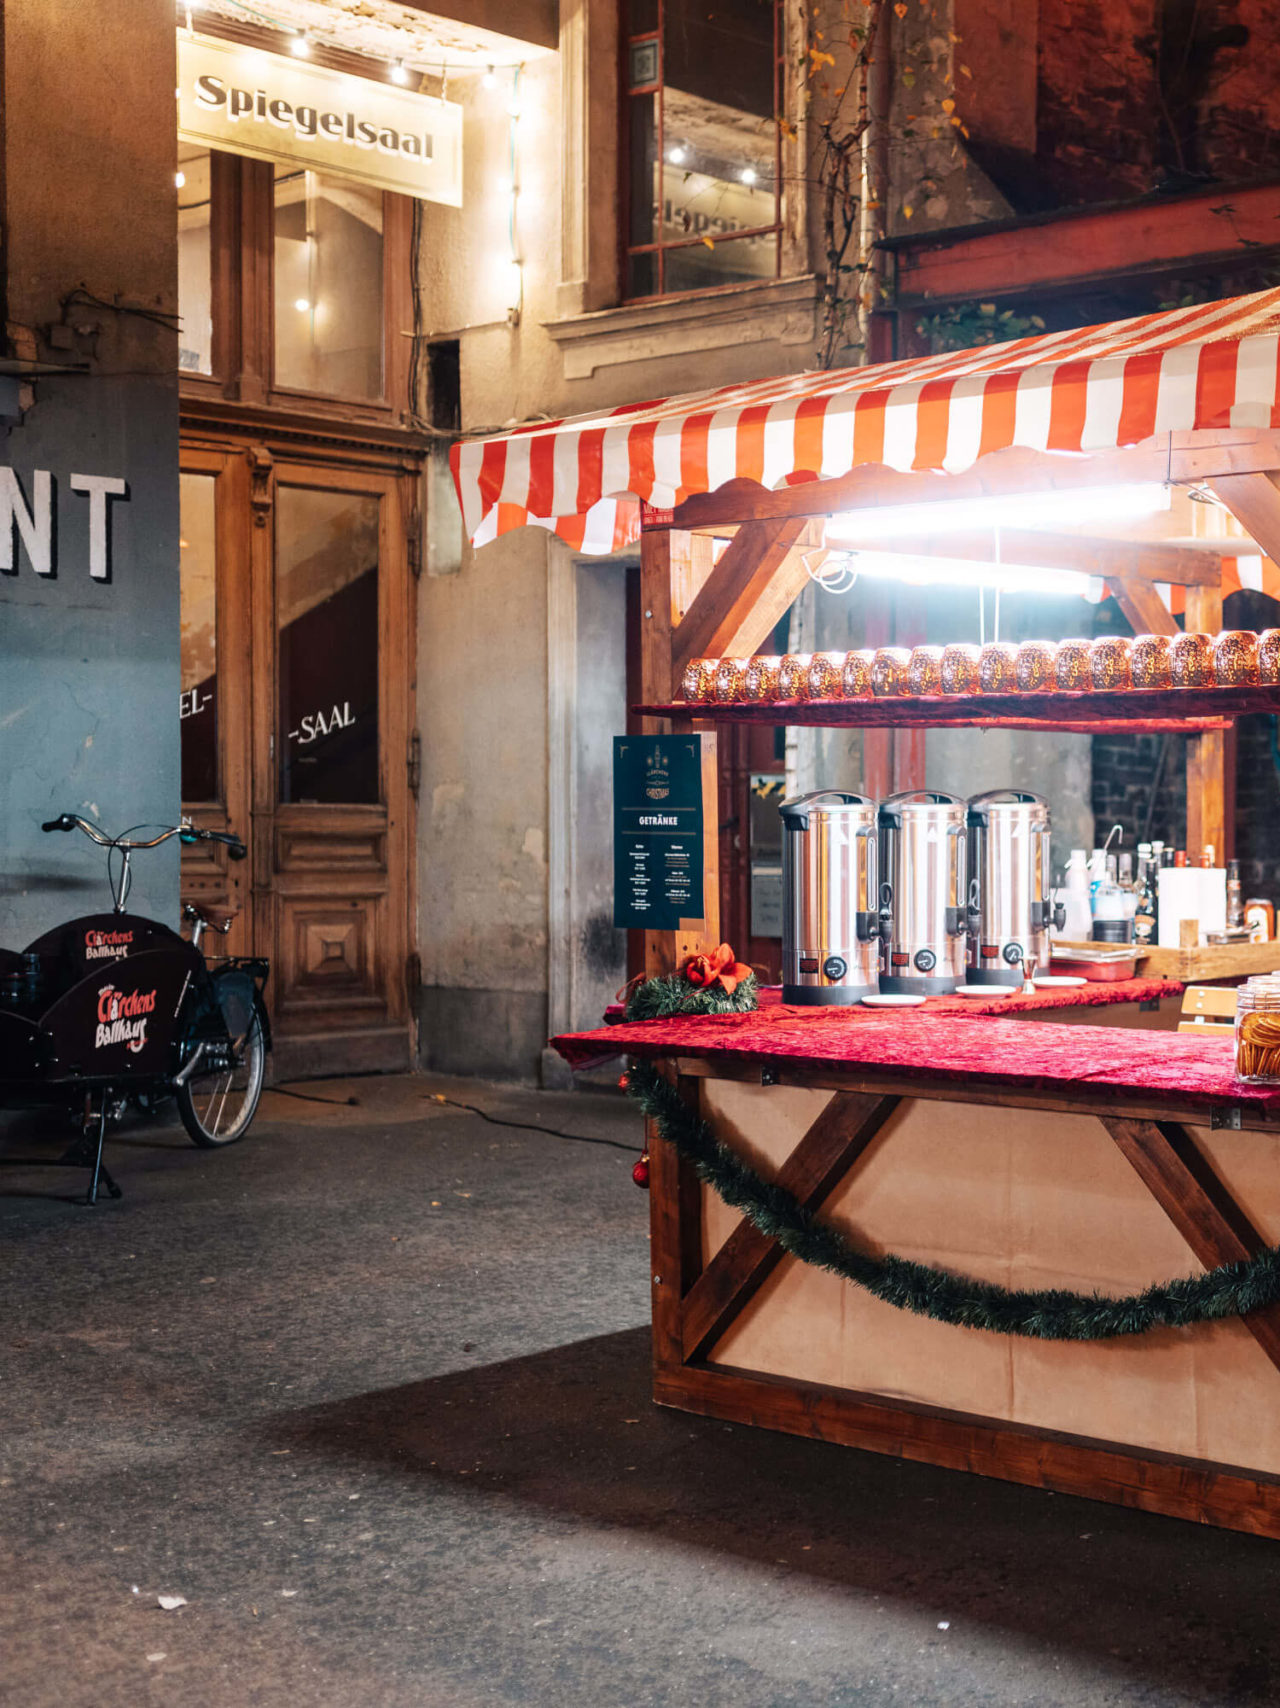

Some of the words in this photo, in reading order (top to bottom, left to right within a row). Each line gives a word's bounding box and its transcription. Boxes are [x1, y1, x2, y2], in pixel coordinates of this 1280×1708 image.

[195, 75, 434, 160] Spiegelsaal
[0, 466, 127, 580] NT
[288, 701, 356, 744] -SAAL
[638, 813, 678, 826] GETRÄNKE
[85, 930, 134, 947] Clärchens
[86, 945, 129, 961] Ballhaus
[98, 988, 157, 1023] Clärchens
[95, 1017, 148, 1053] Ballhaus
